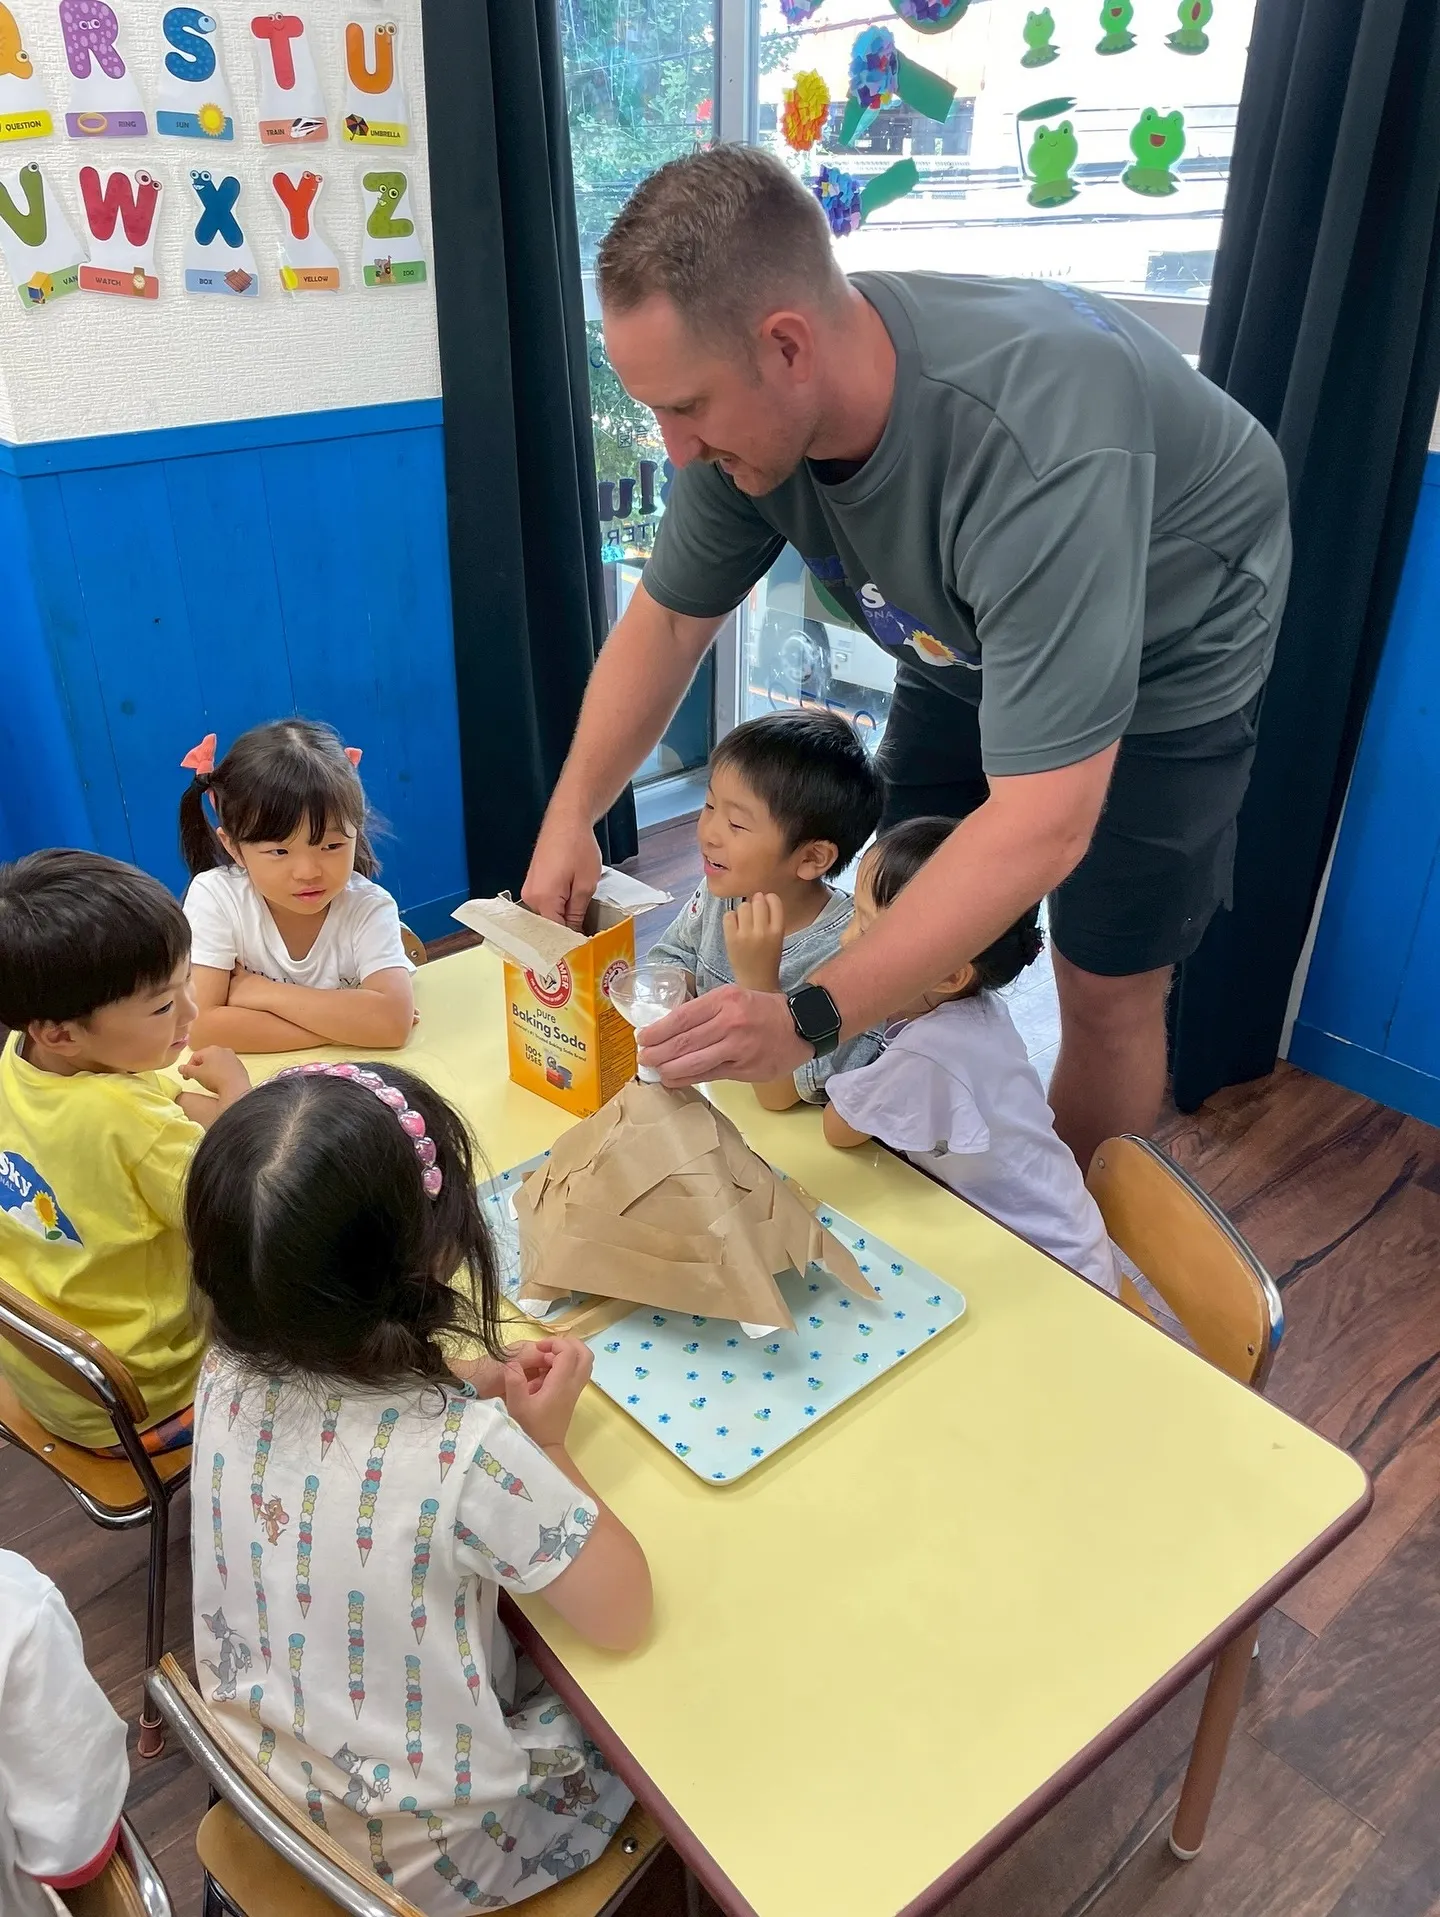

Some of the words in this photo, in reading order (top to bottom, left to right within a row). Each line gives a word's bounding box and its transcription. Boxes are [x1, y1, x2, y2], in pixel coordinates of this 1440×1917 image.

[60, 0, 126, 80] R
[163, 7, 217, 82] S
[250, 13, 304, 91] T
[345, 21, 398, 94] U
[5, 120, 42, 132] QUESTION
[175, 120, 190, 129] SUN
[266, 128, 285, 136] TRAIN
[370, 129, 401, 138] UMBRELLA
[0, 162, 47, 247] V
[79, 166, 162, 247] W
[190, 169, 244, 248] X
[272, 170, 323, 240] Y
[363, 171, 415, 239] Z
[63, 275, 78, 286] VAN
[95, 277, 122, 287] WATCH
[303, 275, 329, 283] YELLOW
[512, 1003, 552, 1038] Baking
[553, 1026, 587, 1051] Soda
[536, 1008, 557, 1024] pure
[525, 1043, 542, 1058] 100+
[525, 1052, 542, 1067] USES
